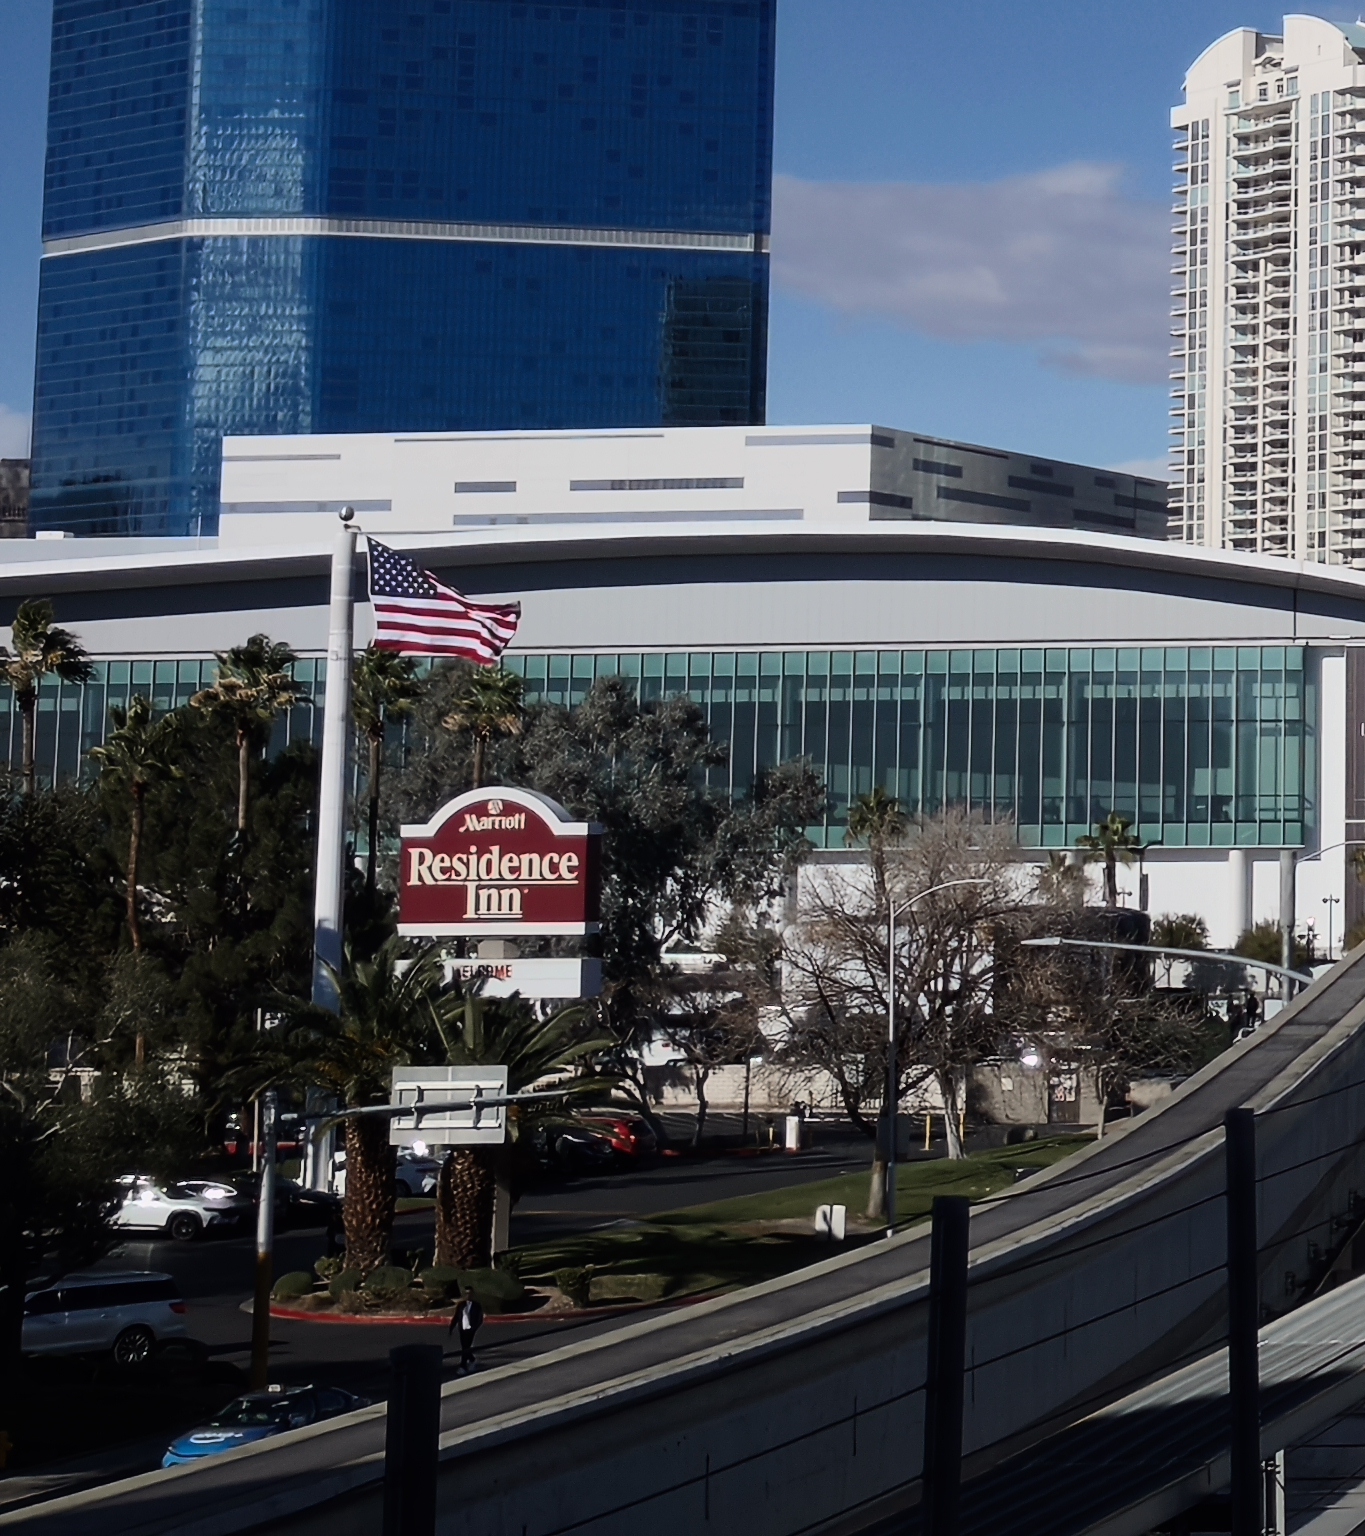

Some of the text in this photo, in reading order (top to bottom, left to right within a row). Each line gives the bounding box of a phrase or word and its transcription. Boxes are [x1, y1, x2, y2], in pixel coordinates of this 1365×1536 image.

[458, 812, 526, 832] Marriott
[406, 845, 580, 886] Residence
[462, 881, 523, 919] Inn
[452, 964, 512, 979] ELCOME
